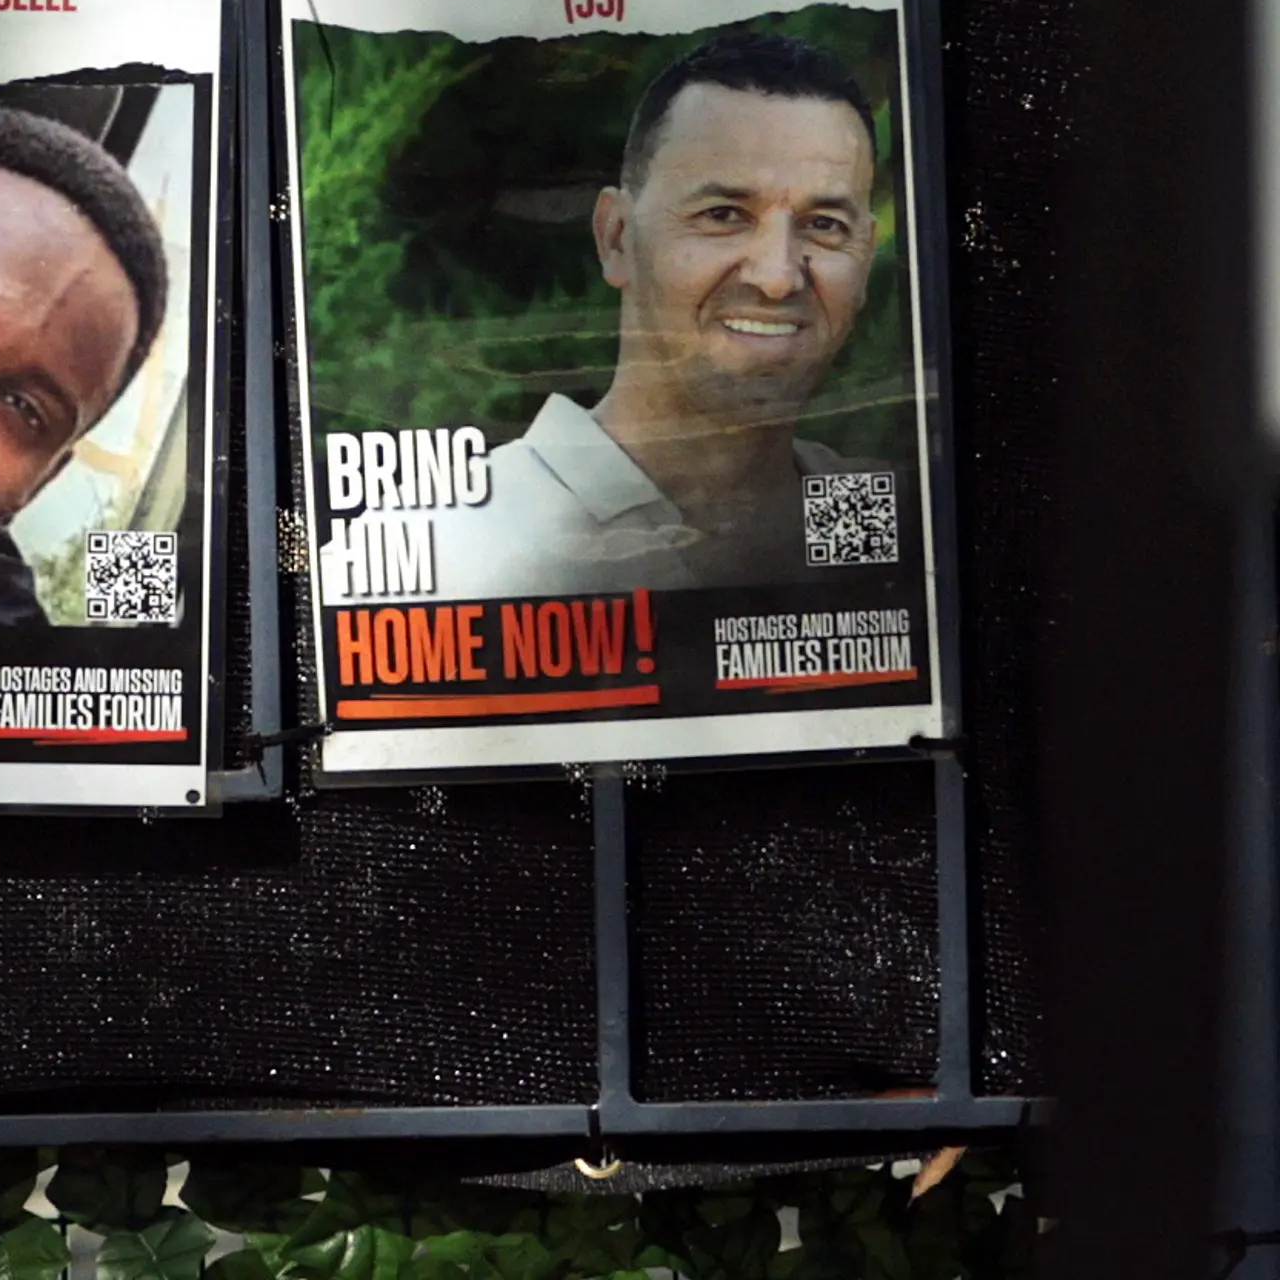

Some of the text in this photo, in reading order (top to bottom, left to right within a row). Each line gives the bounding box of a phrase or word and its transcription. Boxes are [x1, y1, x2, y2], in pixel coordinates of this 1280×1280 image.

[327, 426, 491, 511] BRING
[330, 518, 435, 597] HIM
[336, 588, 657, 687] HOME NOW!
